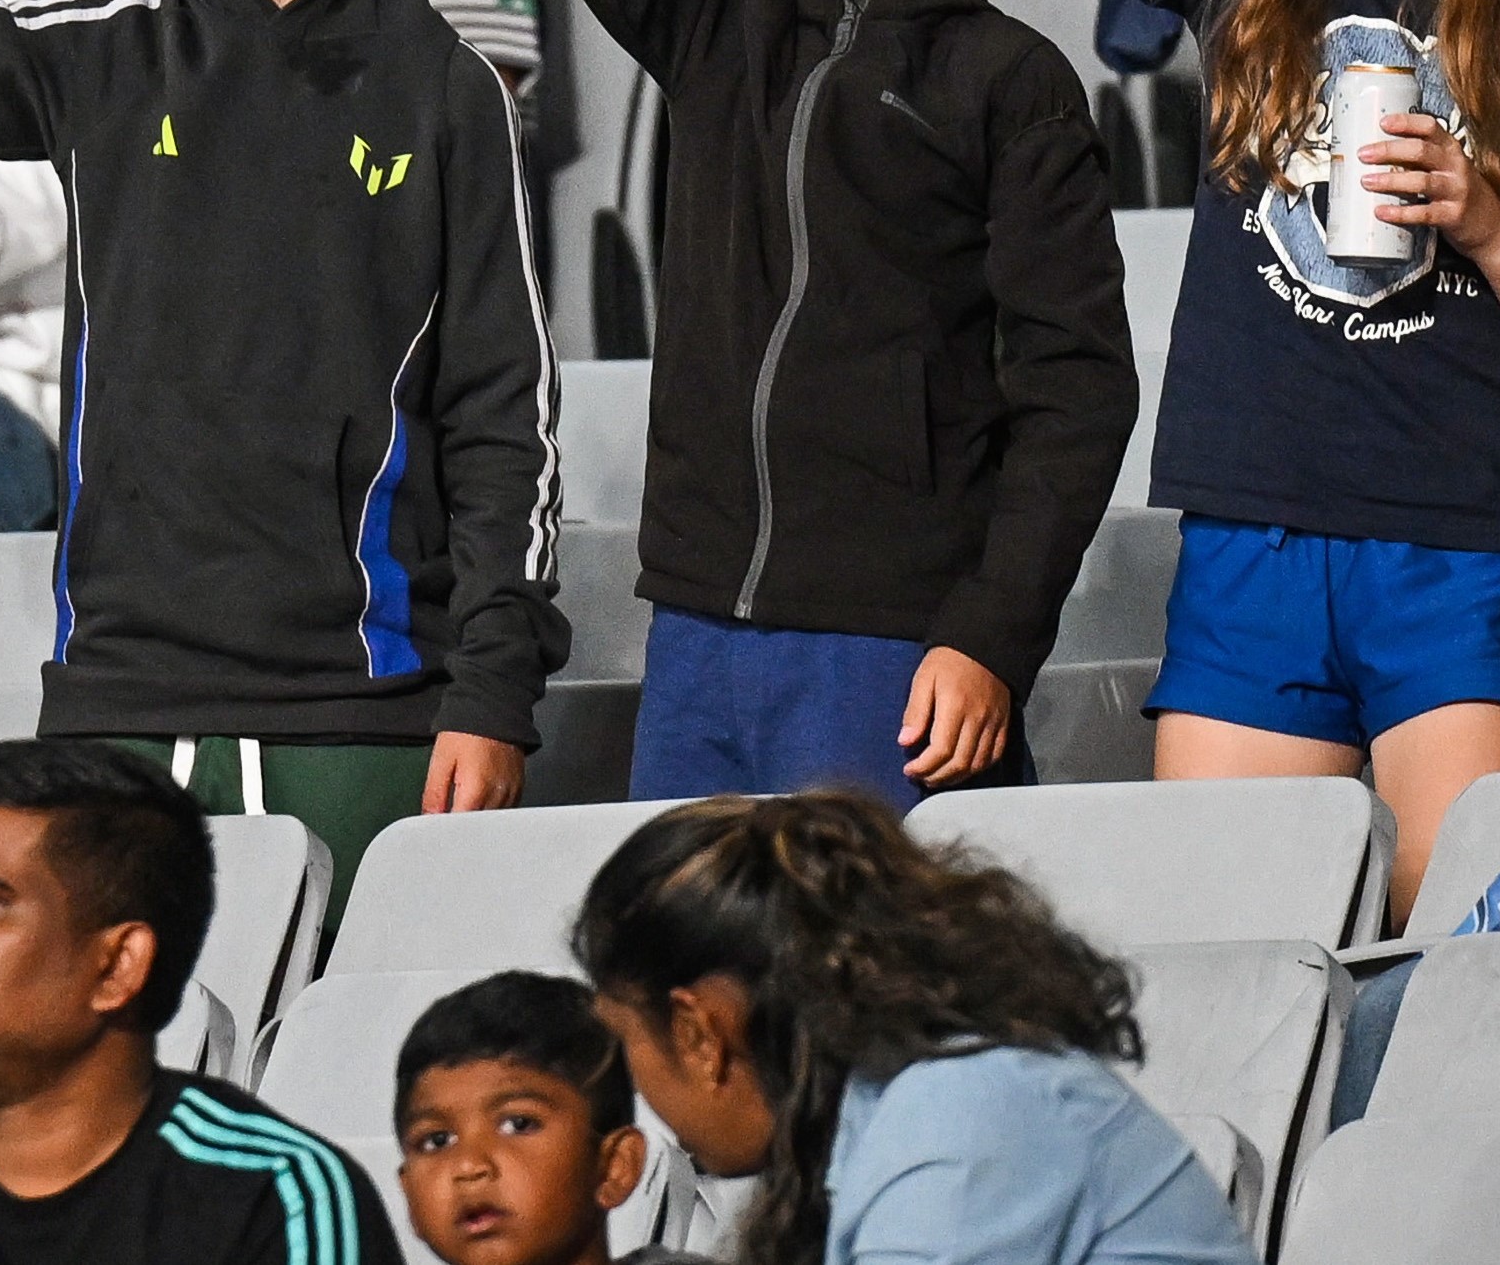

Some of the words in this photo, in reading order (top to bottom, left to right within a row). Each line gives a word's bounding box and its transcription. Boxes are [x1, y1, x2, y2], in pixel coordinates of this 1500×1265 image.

[1257, 263, 1292, 301] New
[1291, 286, 1335, 327] Yor
[1343, 311, 1436, 343] Campus
[1436, 271, 1478, 298] NYC
